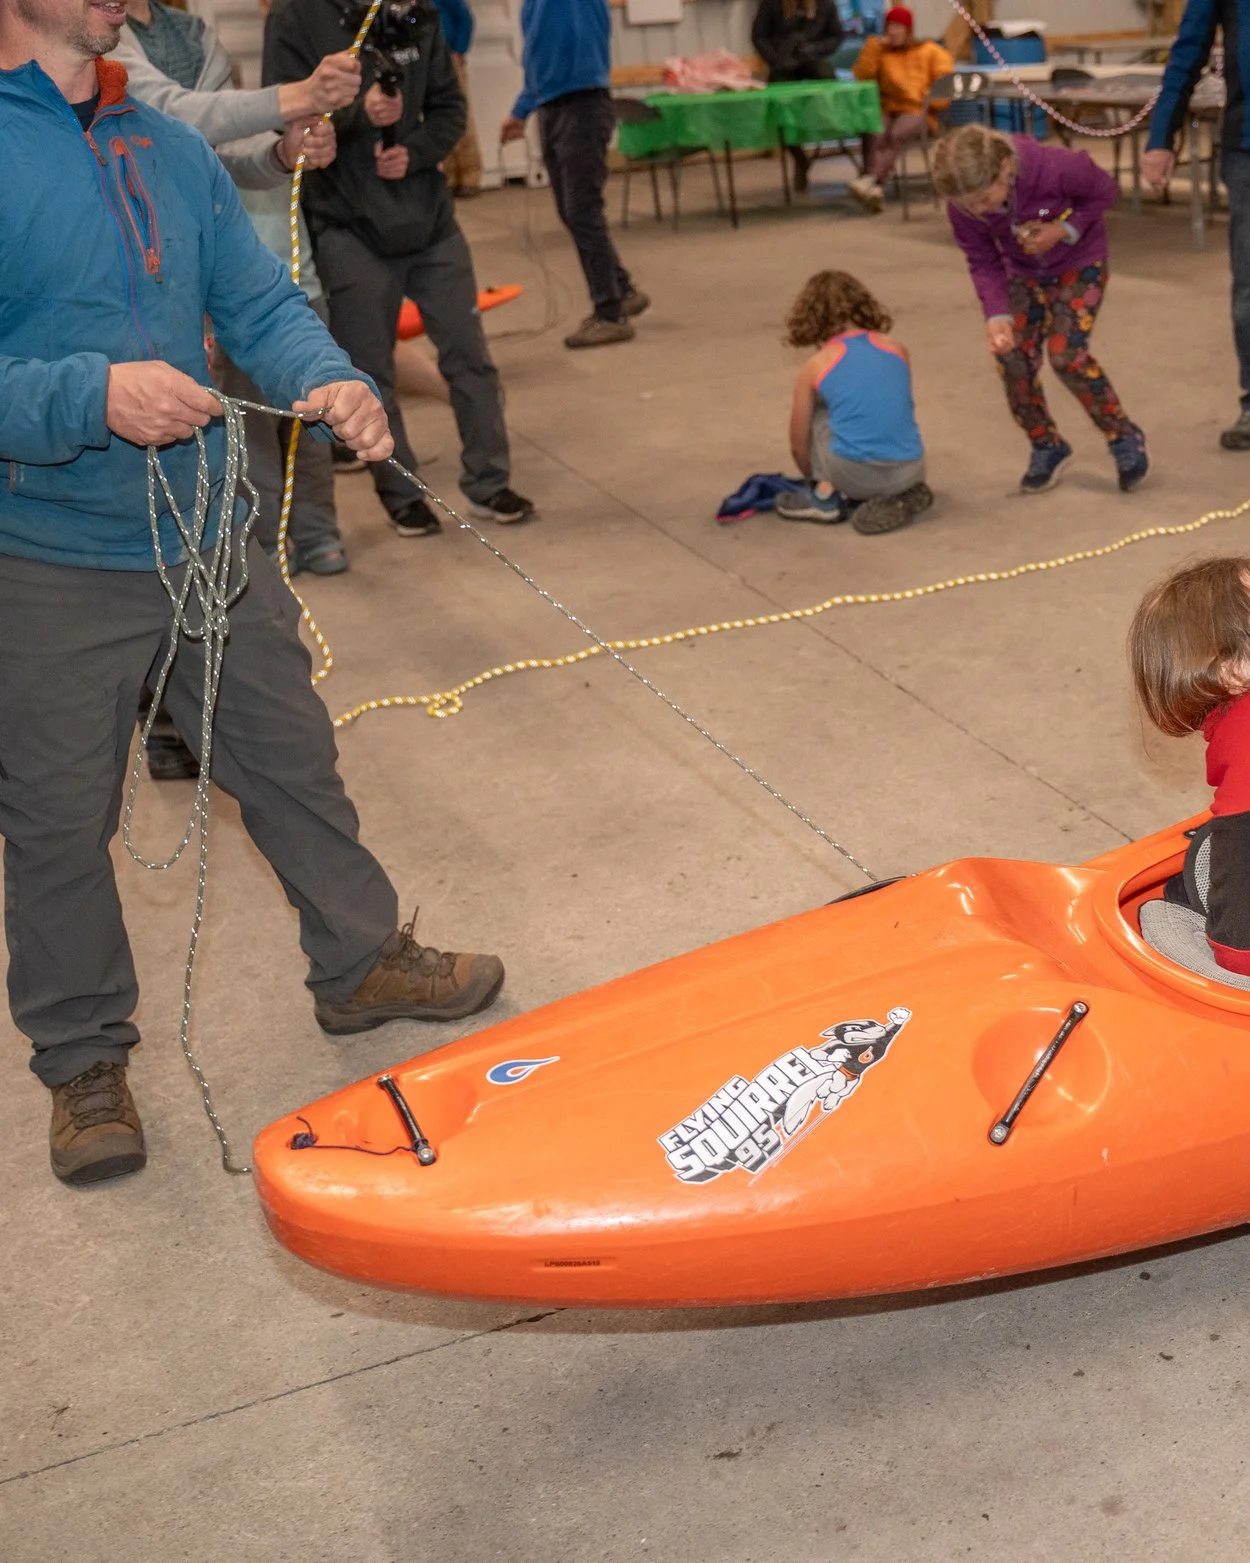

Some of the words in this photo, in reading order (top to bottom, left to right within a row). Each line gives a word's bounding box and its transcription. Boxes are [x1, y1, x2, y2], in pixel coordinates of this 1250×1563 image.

[659, 1076, 749, 1151] FLYING
[666, 1048, 836, 1181] SQUIRREL
[735, 1125, 781, 1169] 95
